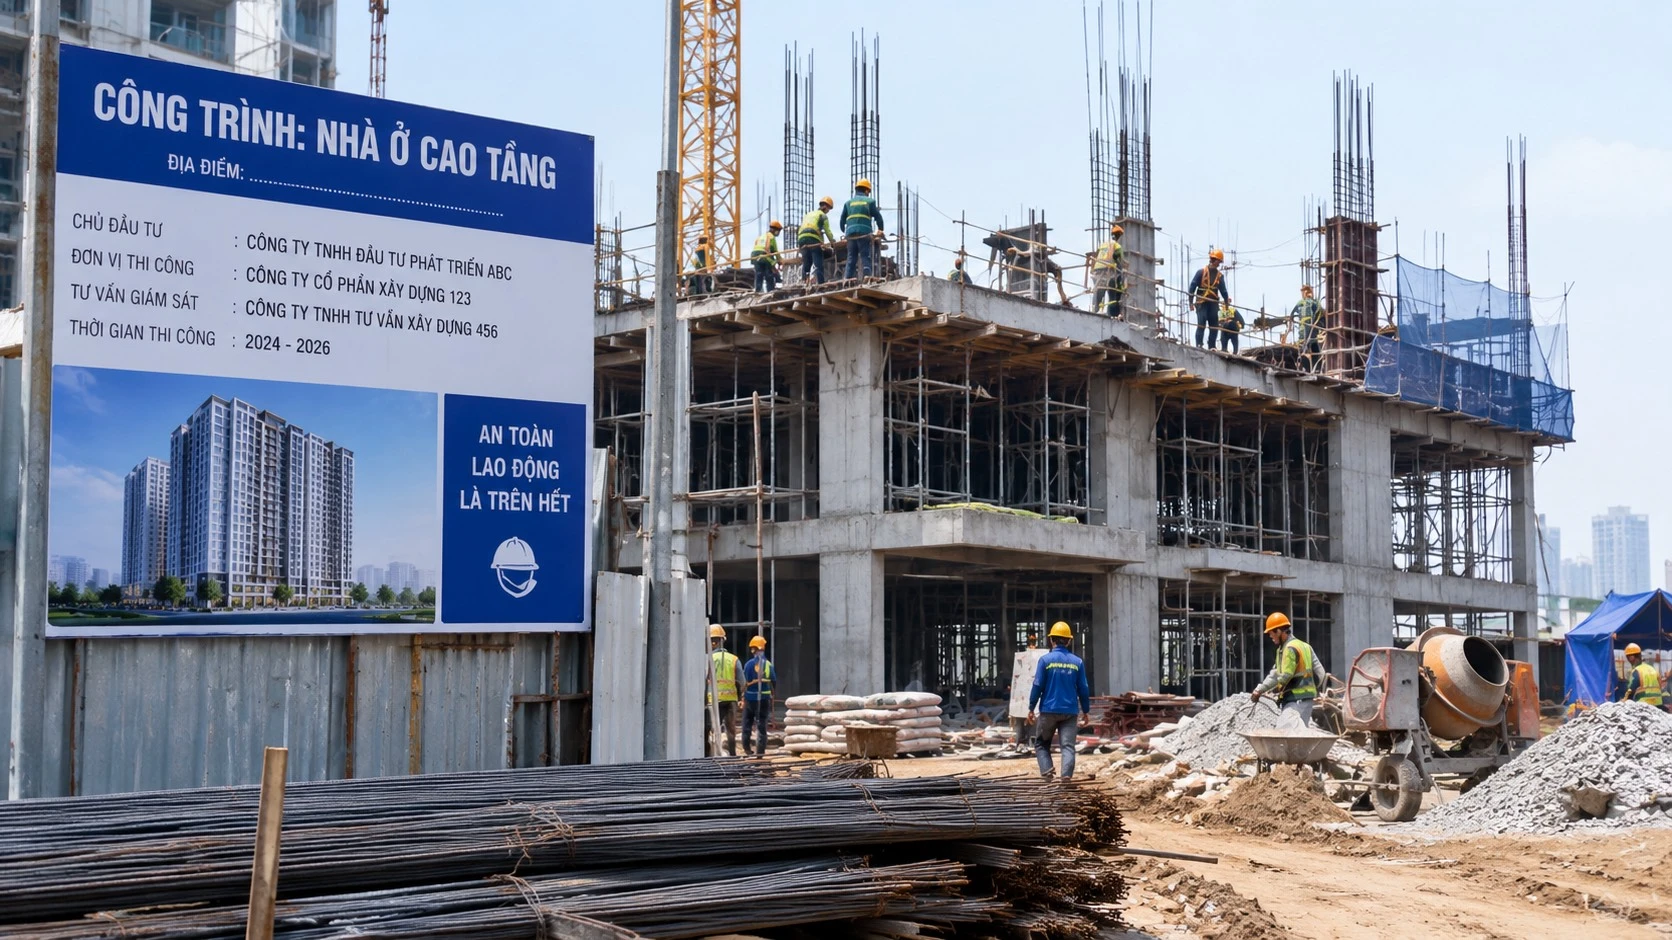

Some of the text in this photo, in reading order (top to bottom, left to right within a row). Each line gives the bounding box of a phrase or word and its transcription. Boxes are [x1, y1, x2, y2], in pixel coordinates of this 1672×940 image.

[93, 78, 556, 190] CÔNG TRÌNH: NHÀ Ở CAO TẦNG
[167, 153, 195, 175] ĐỊA
[72, 211, 104, 232] CHỦ
[143, 221, 164, 238] TƯ
[246, 231, 288, 254] CÔNG
[291, 238, 310, 256] TY
[313, 241, 352, 262] TNHH
[387, 250, 407, 268] TƯ
[486, 264, 512, 281] ABC
[71, 247, 103, 267] ĐƠN
[107, 250, 123, 272] VỊ
[126, 253, 150, 272] THI
[154, 254, 194, 276] CÔNG
[246, 264, 287, 286] CÔNG
[291, 271, 310, 288] TY
[408, 284, 445, 304] DỰNG
[449, 290, 472, 306] 123
[70, 283, 92, 301] TƯ
[130, 287, 167, 308] GIÁM
[172, 290, 199, 311] SÁT
[245, 297, 287, 319] CÔNG
[290, 303, 309, 321] TY
[312, 305, 351, 325] TNHH
[354, 310, 374, 327] TƯ
[436, 318, 472, 338] DỰNG
[475, 323, 498, 339] 456
[69, 317, 104, 337] THỜI
[109, 322, 144, 341] GIAN
[148, 325, 171, 343] THI
[176, 325, 216, 347] CÔNG
[244, 333, 281, 352] 2024
[296, 337, 331, 356] 2026
[478, 423, 553, 448] AN TOÀN
[472, 455, 560, 483] LAO ĐỘNG
[460, 485, 571, 513] LÀ TRÊN HẾT
